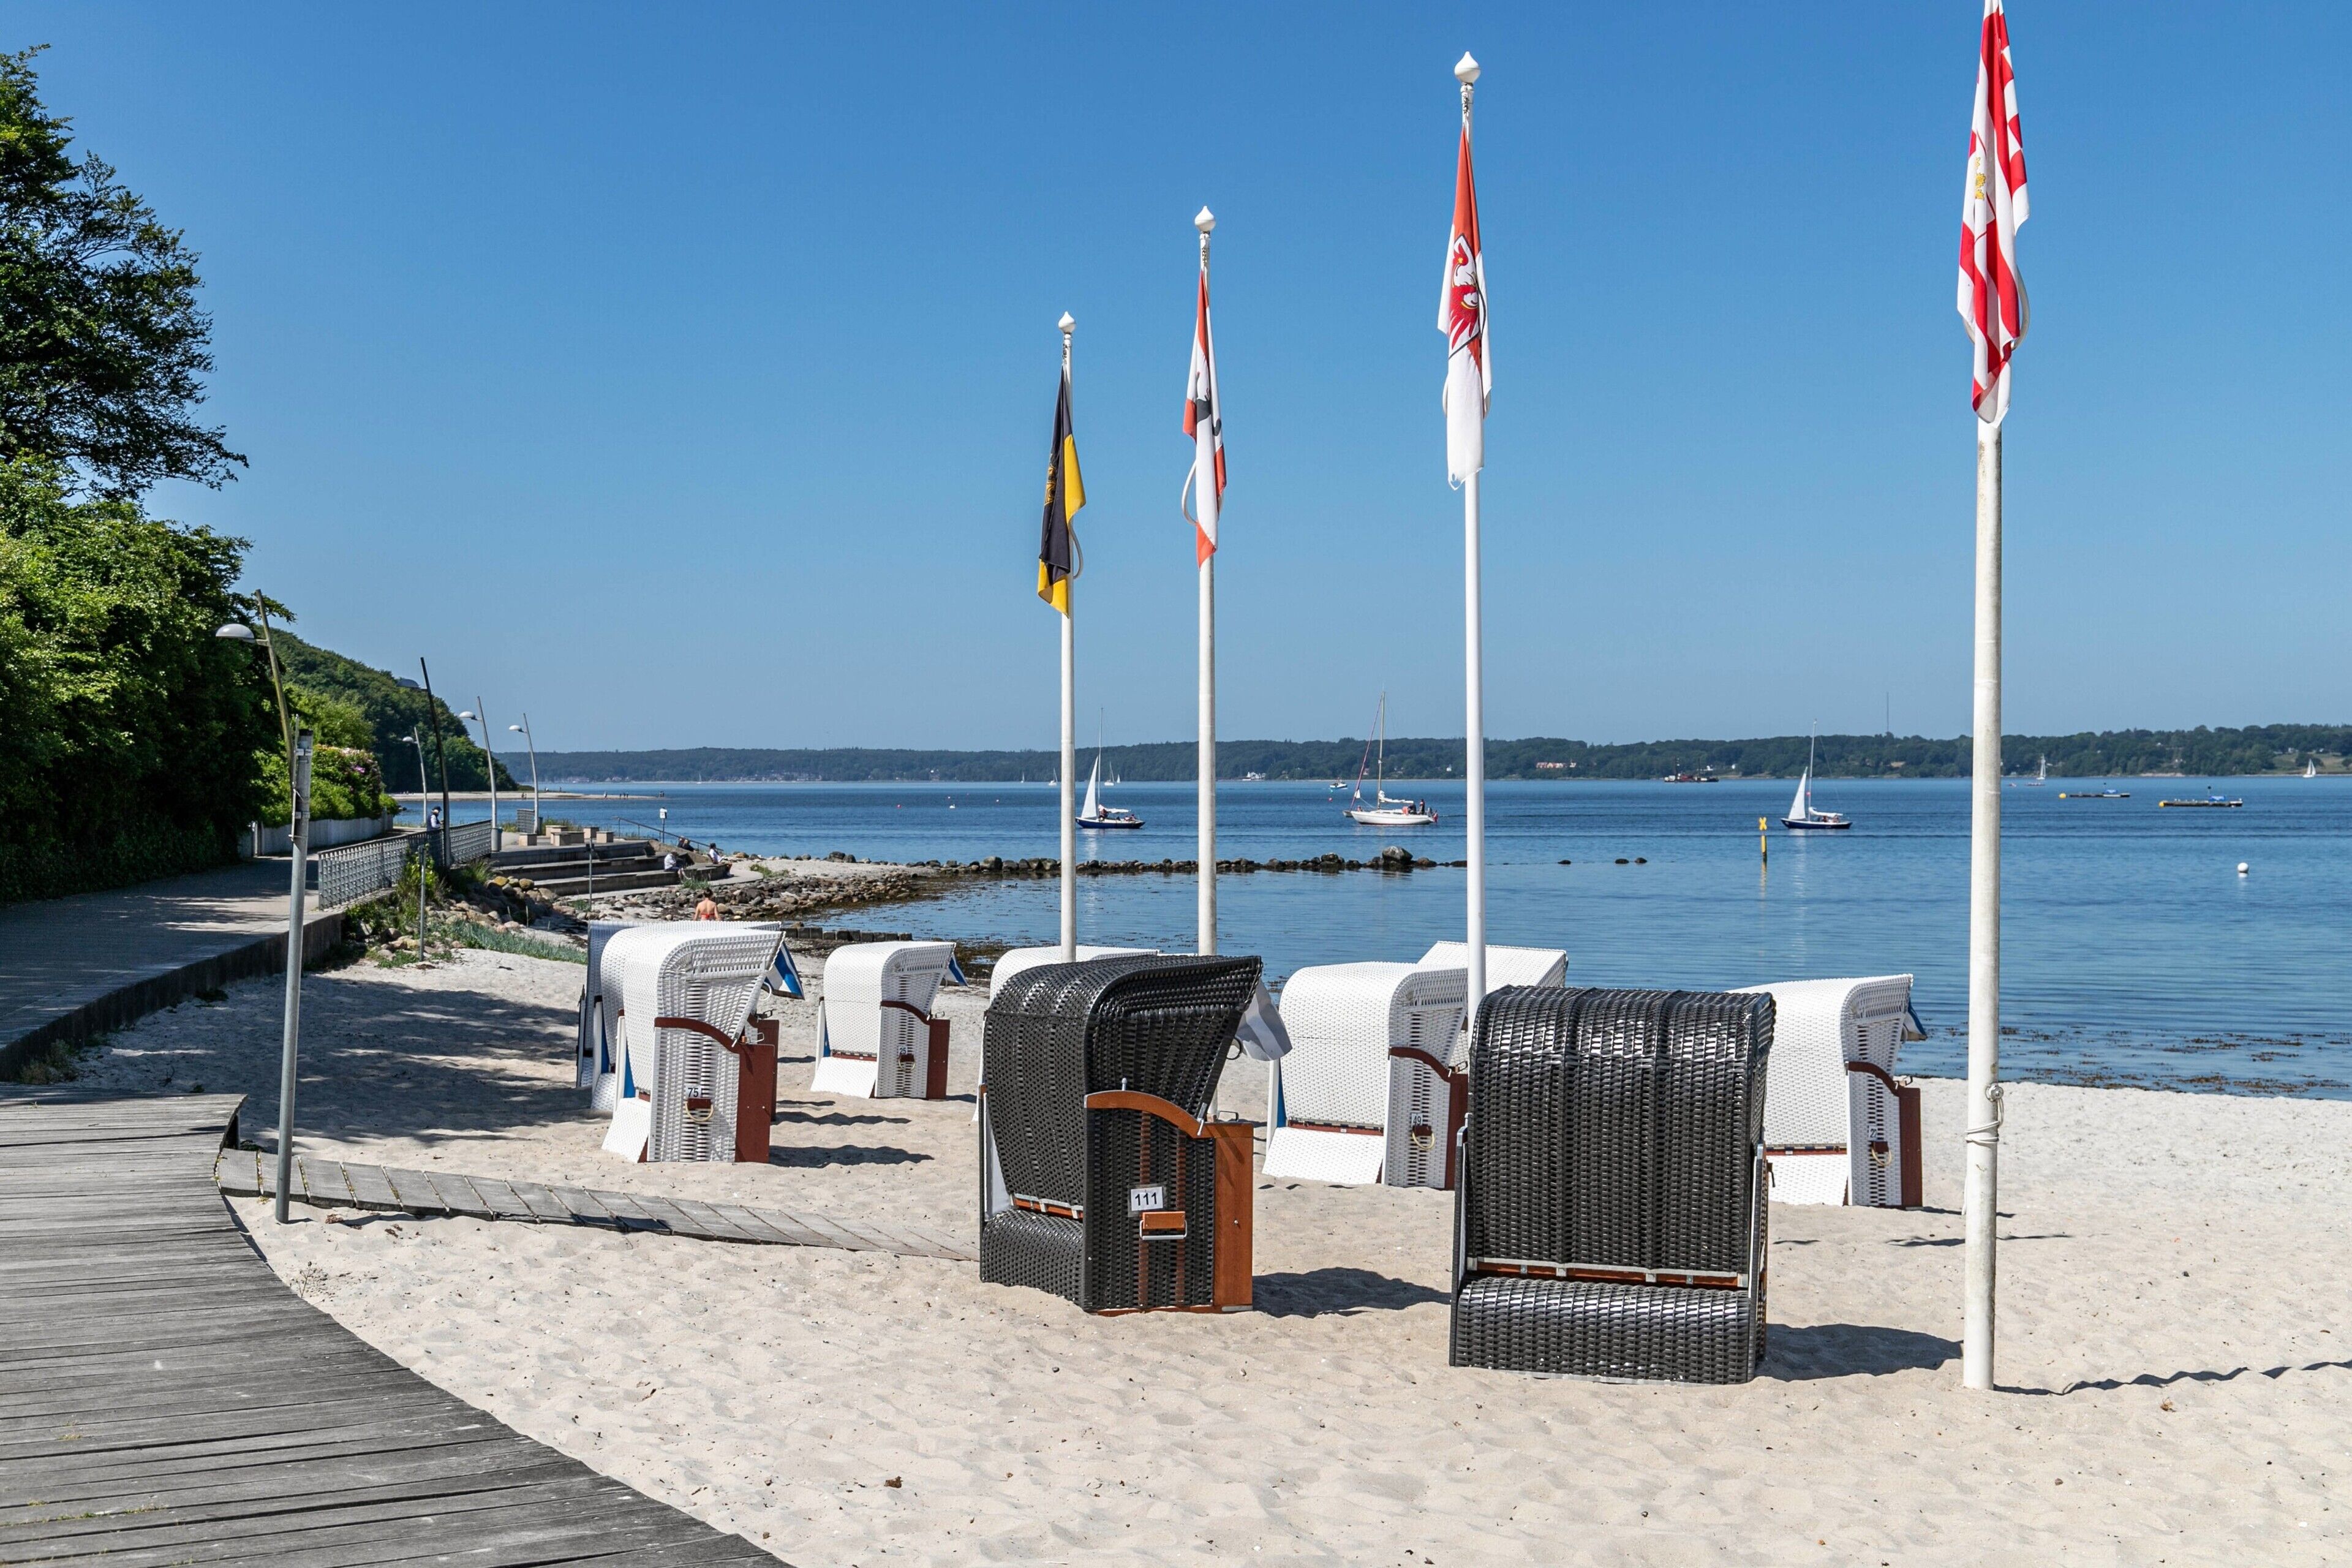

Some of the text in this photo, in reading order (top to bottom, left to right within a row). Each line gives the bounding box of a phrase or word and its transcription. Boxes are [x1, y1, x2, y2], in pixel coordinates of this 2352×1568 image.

[687, 1087, 699, 1098] 75
[1413, 1115, 1422, 1126] 49
[1134, 1192, 1158, 1206] 111
